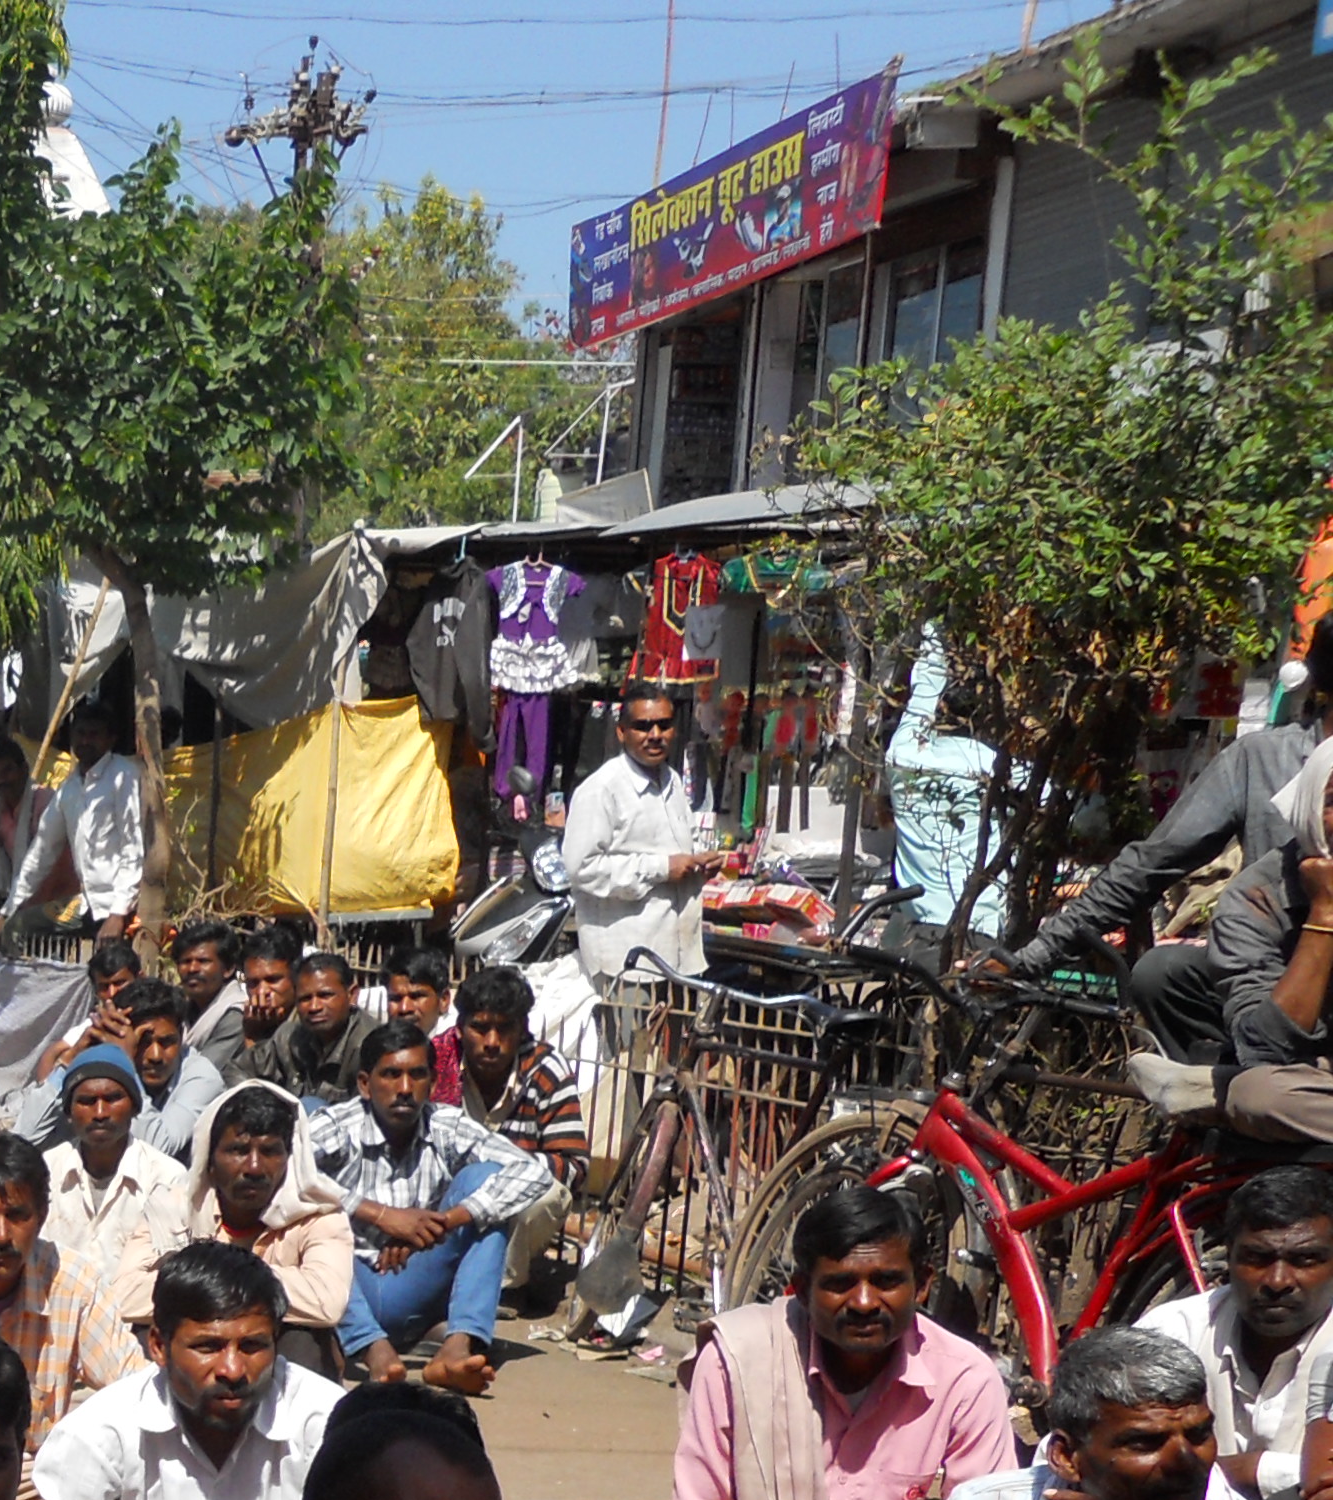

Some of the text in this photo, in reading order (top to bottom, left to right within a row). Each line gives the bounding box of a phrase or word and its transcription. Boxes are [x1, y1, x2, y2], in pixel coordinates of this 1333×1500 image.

[630, 131, 805, 252] सिलेक्शन बूट हाउस
